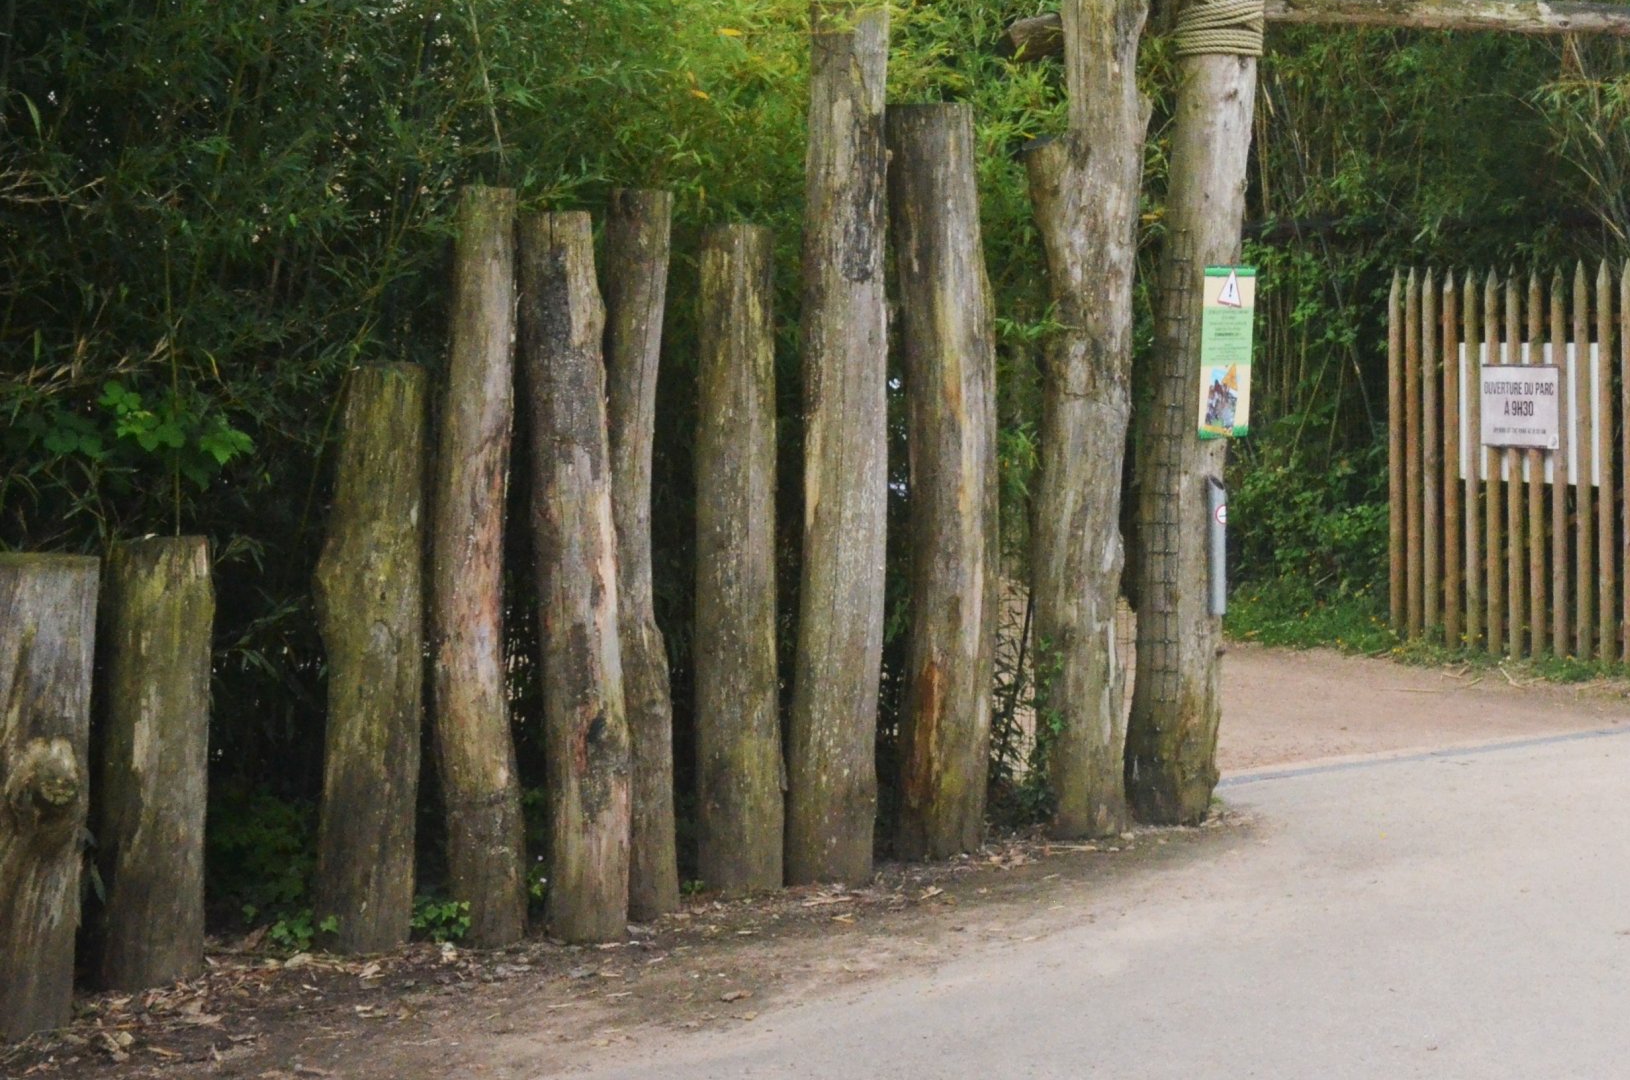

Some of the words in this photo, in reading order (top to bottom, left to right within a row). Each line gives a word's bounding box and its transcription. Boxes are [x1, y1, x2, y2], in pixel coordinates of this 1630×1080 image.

[1483, 381, 1522, 395] OUVERTURE
[1524, 382, 1534, 395] DU
[1535, 382, 1554, 396] PARC
[1511, 400, 1534, 417] 9H30
